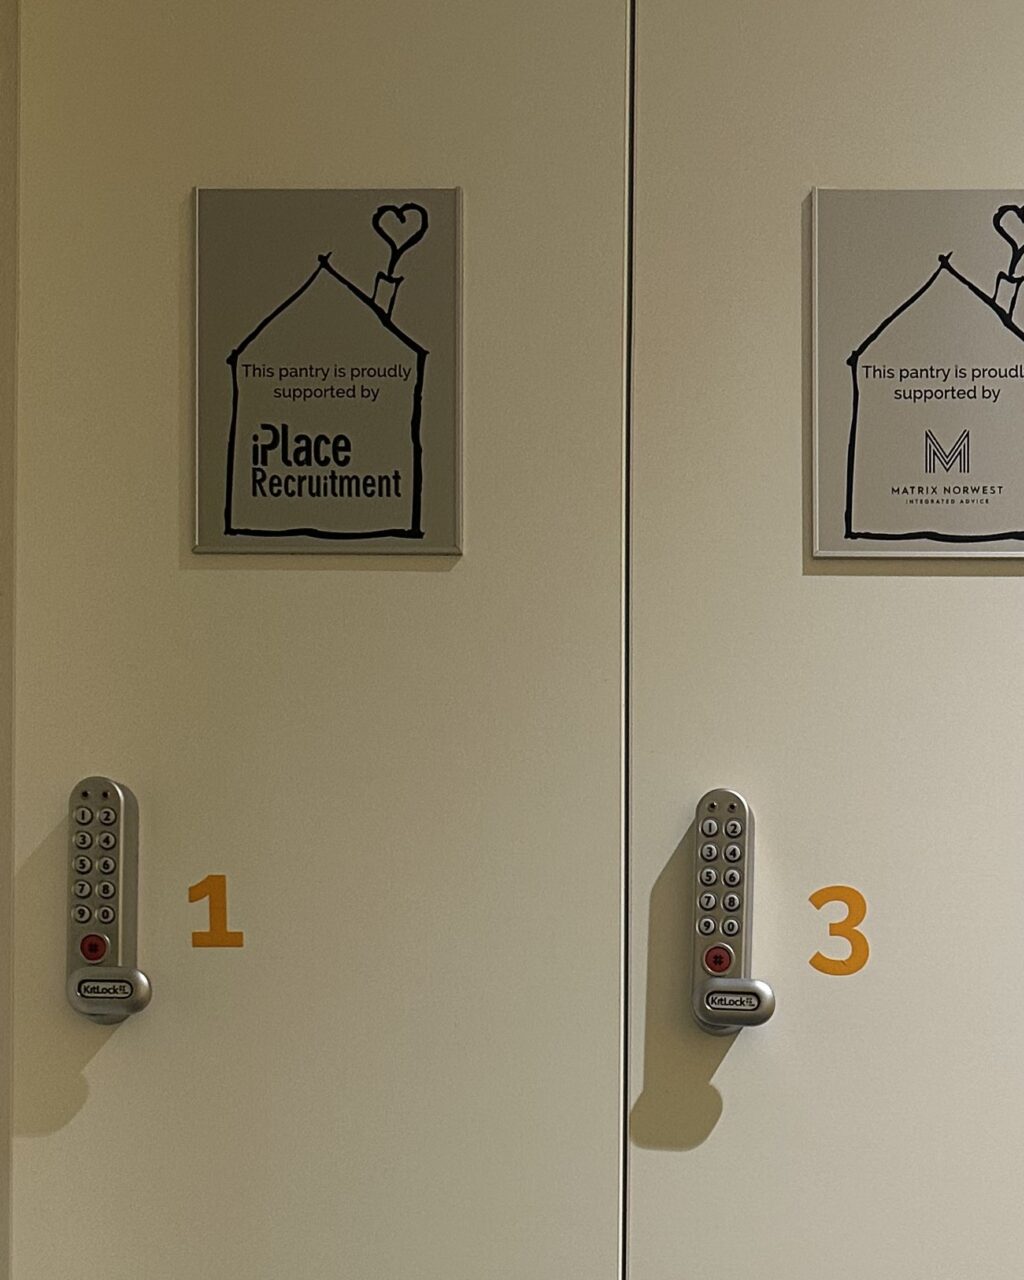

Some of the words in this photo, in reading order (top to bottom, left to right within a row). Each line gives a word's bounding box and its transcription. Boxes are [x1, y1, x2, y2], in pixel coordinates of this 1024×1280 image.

[242, 364, 275, 378] This
[279, 365, 329, 381] pantry
[334, 364, 346, 379] is
[351, 364, 411, 382] proudly
[862, 365, 894, 379] This
[900, 366, 951, 382] pantry
[955, 365, 967, 379] is
[273, 385, 356, 401] supported
[361, 385, 380, 402] by
[894, 386, 976, 403] supported
[982, 386, 1000, 402] by
[252, 423, 352, 467] iPlace
[925, 429, 969, 473] M
[252, 467, 402, 498] Recruitment
[891, 486, 938, 495] MATRIX
[943, 486, 1004, 495] NORWEST
[81, 810, 85, 820] 1
[103, 811, 111, 821] 2
[708, 823, 712, 833] 1
[730, 823, 737, 834] 2
[79, 834, 86, 845] 3
[102, 835, 110, 845] 4
[706, 847, 713, 857] 3
[729, 848, 736, 858] 4
[79, 859, 86, 869] 5
[102, 860, 110, 870] 6
[705, 871, 712, 882] 5
[728, 872, 736, 883] 6
[78, 884, 85, 894] 7
[102, 884, 110, 895] 8
[704, 896, 711, 906] 7
[728, 897, 735, 908] 8
[77, 908, 85, 918] 9
[101, 909, 109, 919] 0
[189, 875, 243, 947] 1
[703, 921, 711, 931] 9
[727, 922, 735, 932] 0
[810, 886, 869, 975] 3
